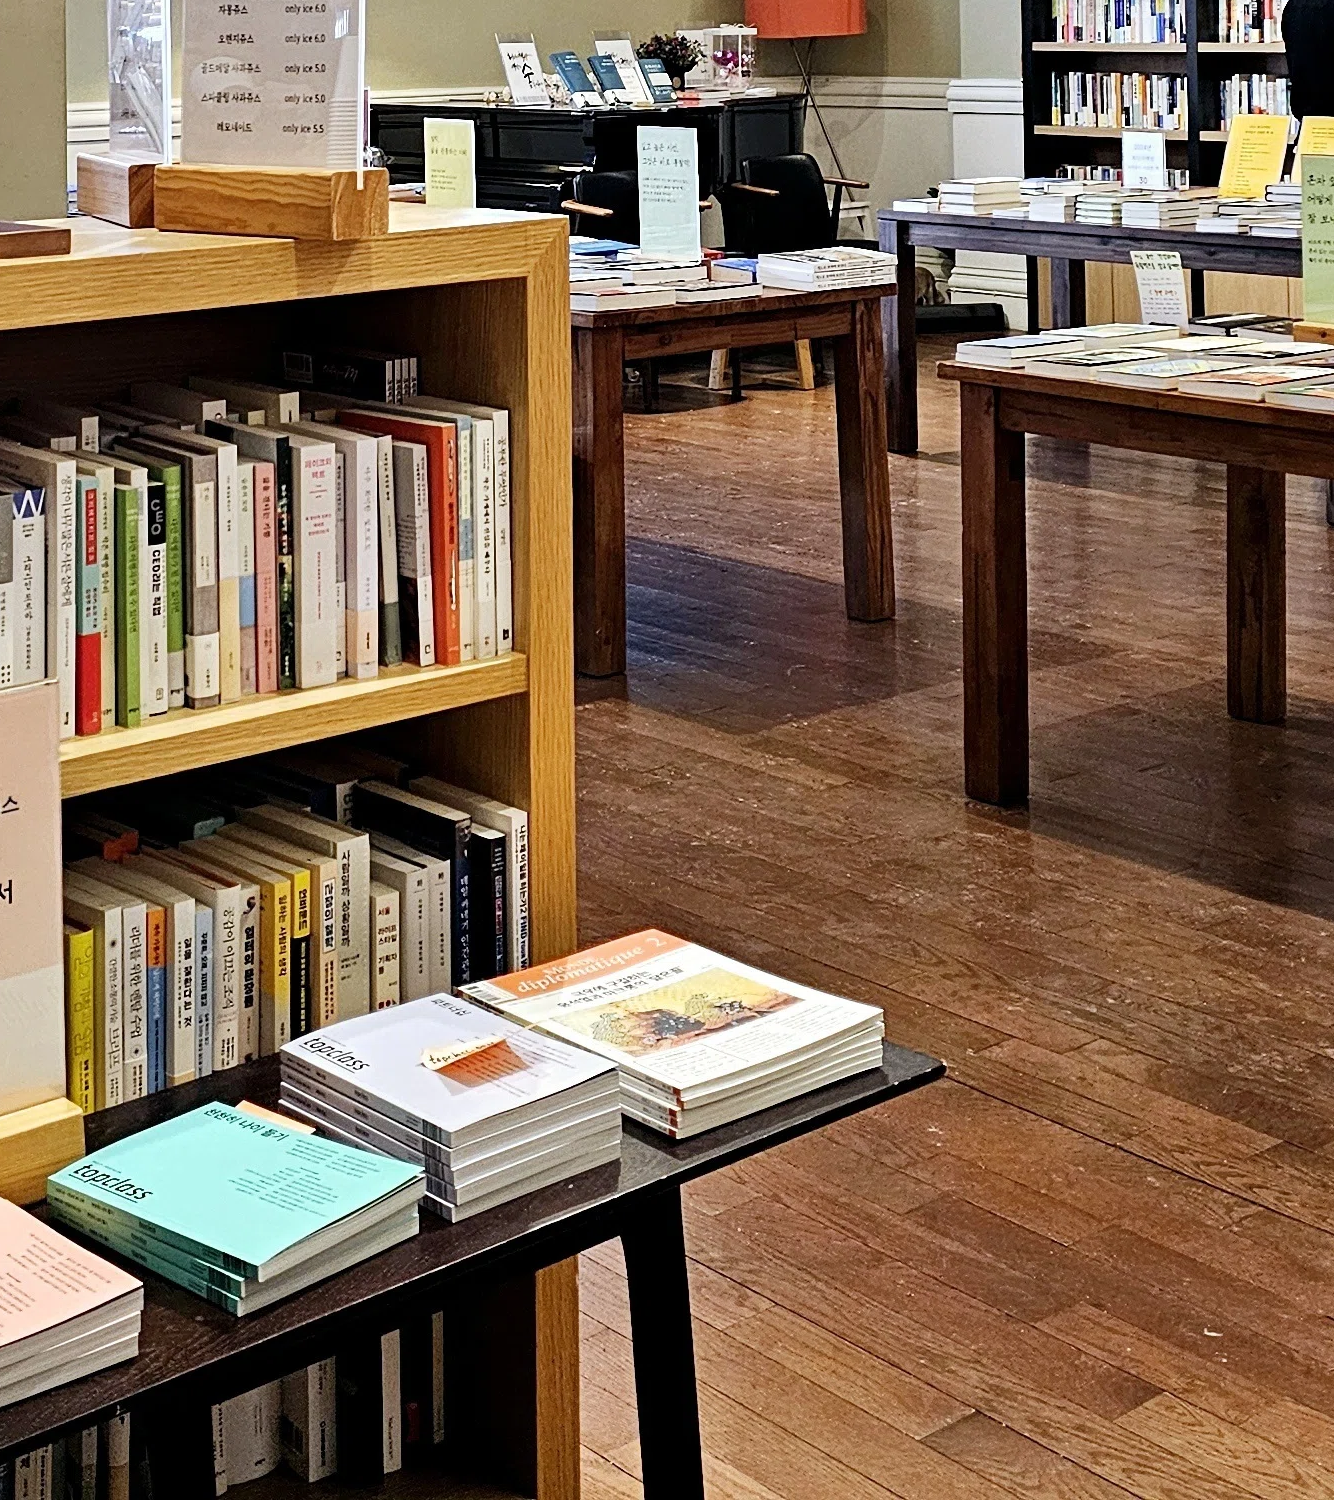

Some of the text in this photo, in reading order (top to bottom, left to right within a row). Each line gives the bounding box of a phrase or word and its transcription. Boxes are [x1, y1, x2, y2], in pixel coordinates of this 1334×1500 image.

[285, 5, 301, 14] only
[303, 4, 313, 13] ice
[315, 4, 326, 13] 6.0
[285, 34, 301, 44] only
[303, 34, 313, 43] ice
[315, 34, 326, 43] 6.0
[285, 65, 301, 74] only
[303, 64, 313, 73] ice
[315, 64, 326, 73] 5.0
[285, 94, 301, 105] only
[303, 94, 313, 102] ice
[315, 94, 326, 103] 5.0
[216, 122, 324, 134] 레모네이드 only ice 5.5
[1139, 176, 1148, 184] 30
[1307, 175, 1326, 186] 혼자
[1307, 193, 1333, 205] 어떻게
[1308, 213, 1316, 223] 잘
[152, 550, 161, 616] CEO라는 직업
[341, 850, 350, 947] 사람일까 상황일까
[299, 889, 308, 931] 언바운드
[378, 907, 390, 915] 서울
[279, 895, 287, 976] 일하는 사람의 생각
[378, 925, 397, 935] 라이프
[378, 935, 397, 944] 스타일
[184, 938, 192, 960] 일을
[223, 908, 235, 1009] 공감이 이끄는 조직
[378, 953, 397, 964] 기획자
[517, 937, 666, 994] diplomatique 2
[130, 927, 142, 1039] 리더를 위한 멘탈 수업
[431, 998, 470, 1017] 파트너십
[184, 1016, 193, 1028] 것
[303, 1036, 370, 1072] topclass
[204, 1108, 289, 1141] 천천히 나이 들기
[72, 1163, 154, 1201] topclass
